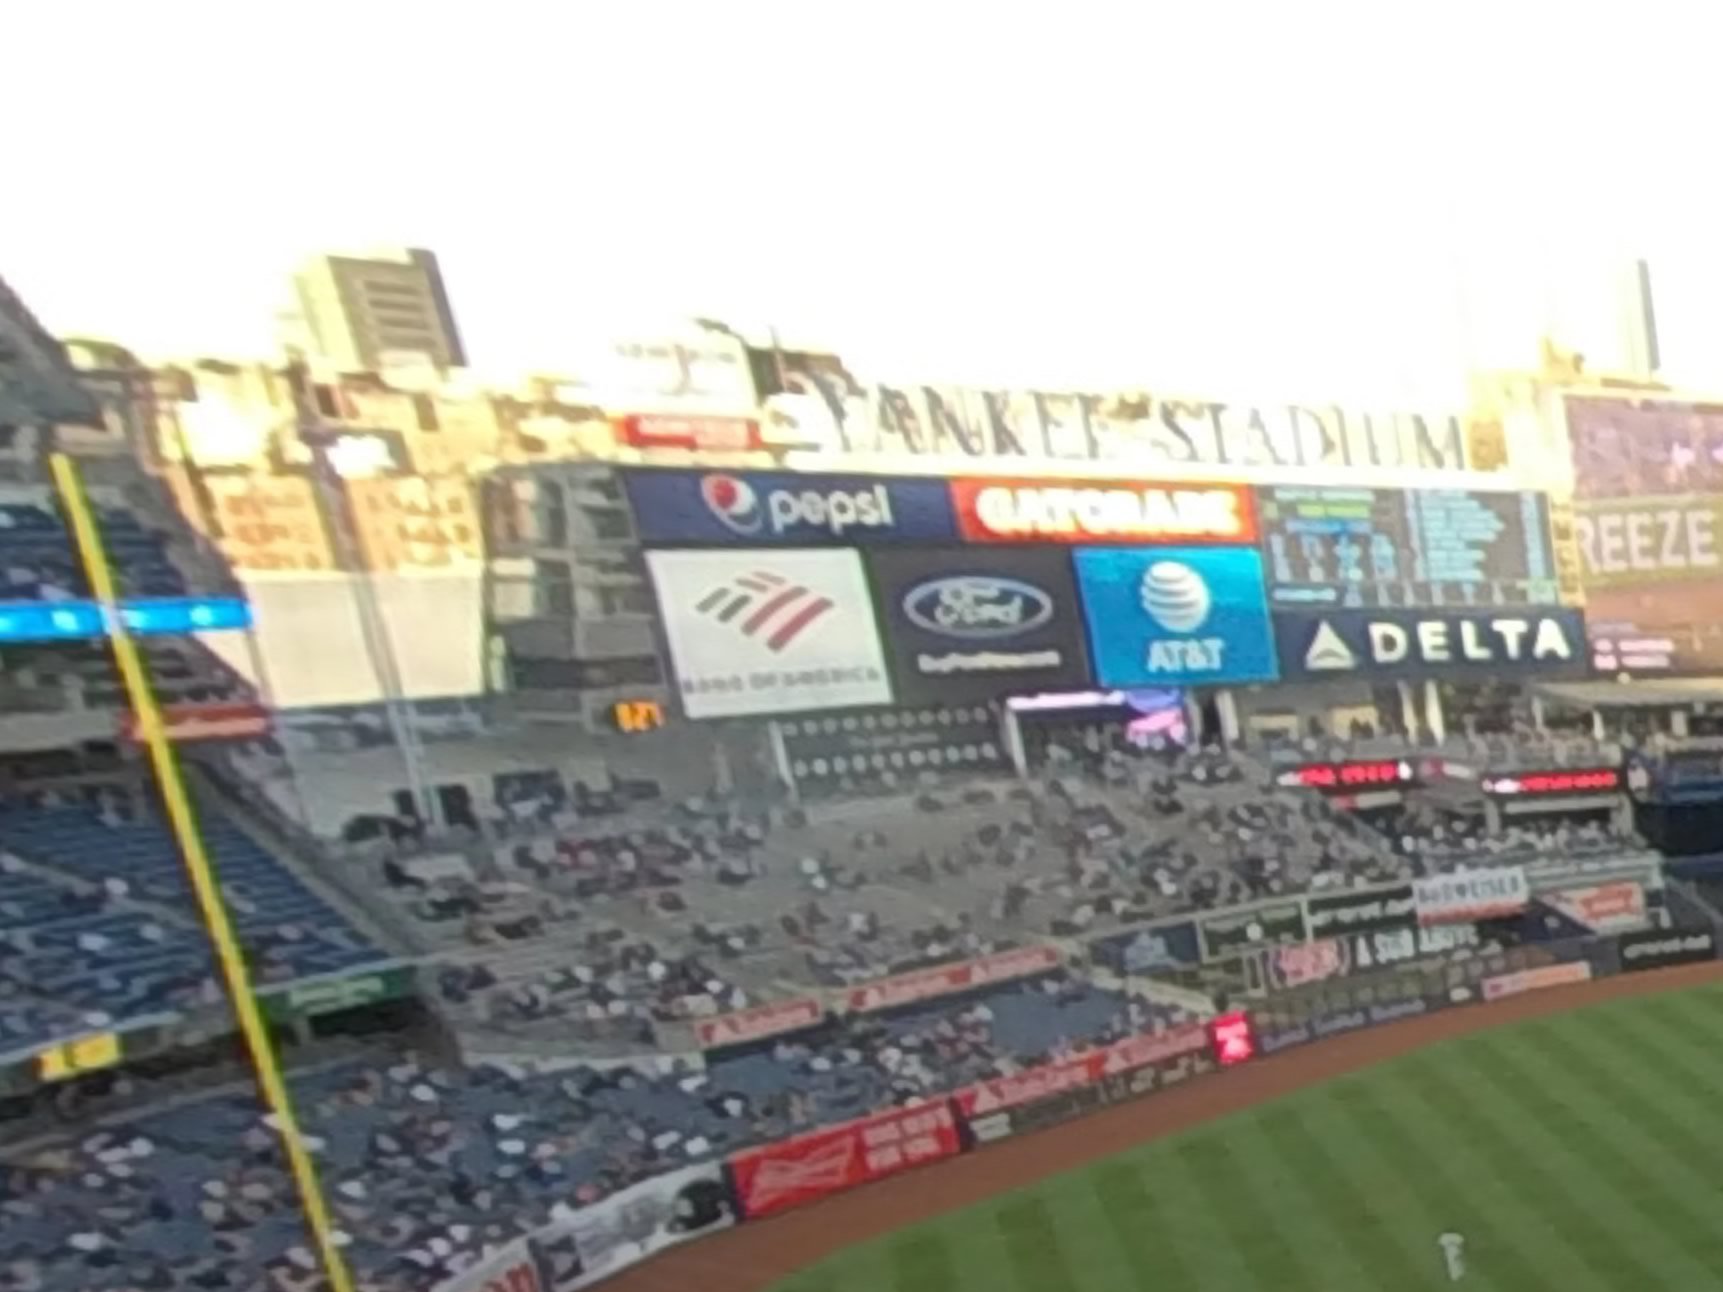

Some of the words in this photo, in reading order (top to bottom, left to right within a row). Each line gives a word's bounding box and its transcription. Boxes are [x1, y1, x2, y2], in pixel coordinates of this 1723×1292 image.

[769, 485, 894, 533] pepsi
[1578, 509, 1719, 574] REEZE
[933, 584, 1024, 625] Ford
[1147, 639, 1225, 672] AT&T
[1368, 617, 1571, 665] DELTA
